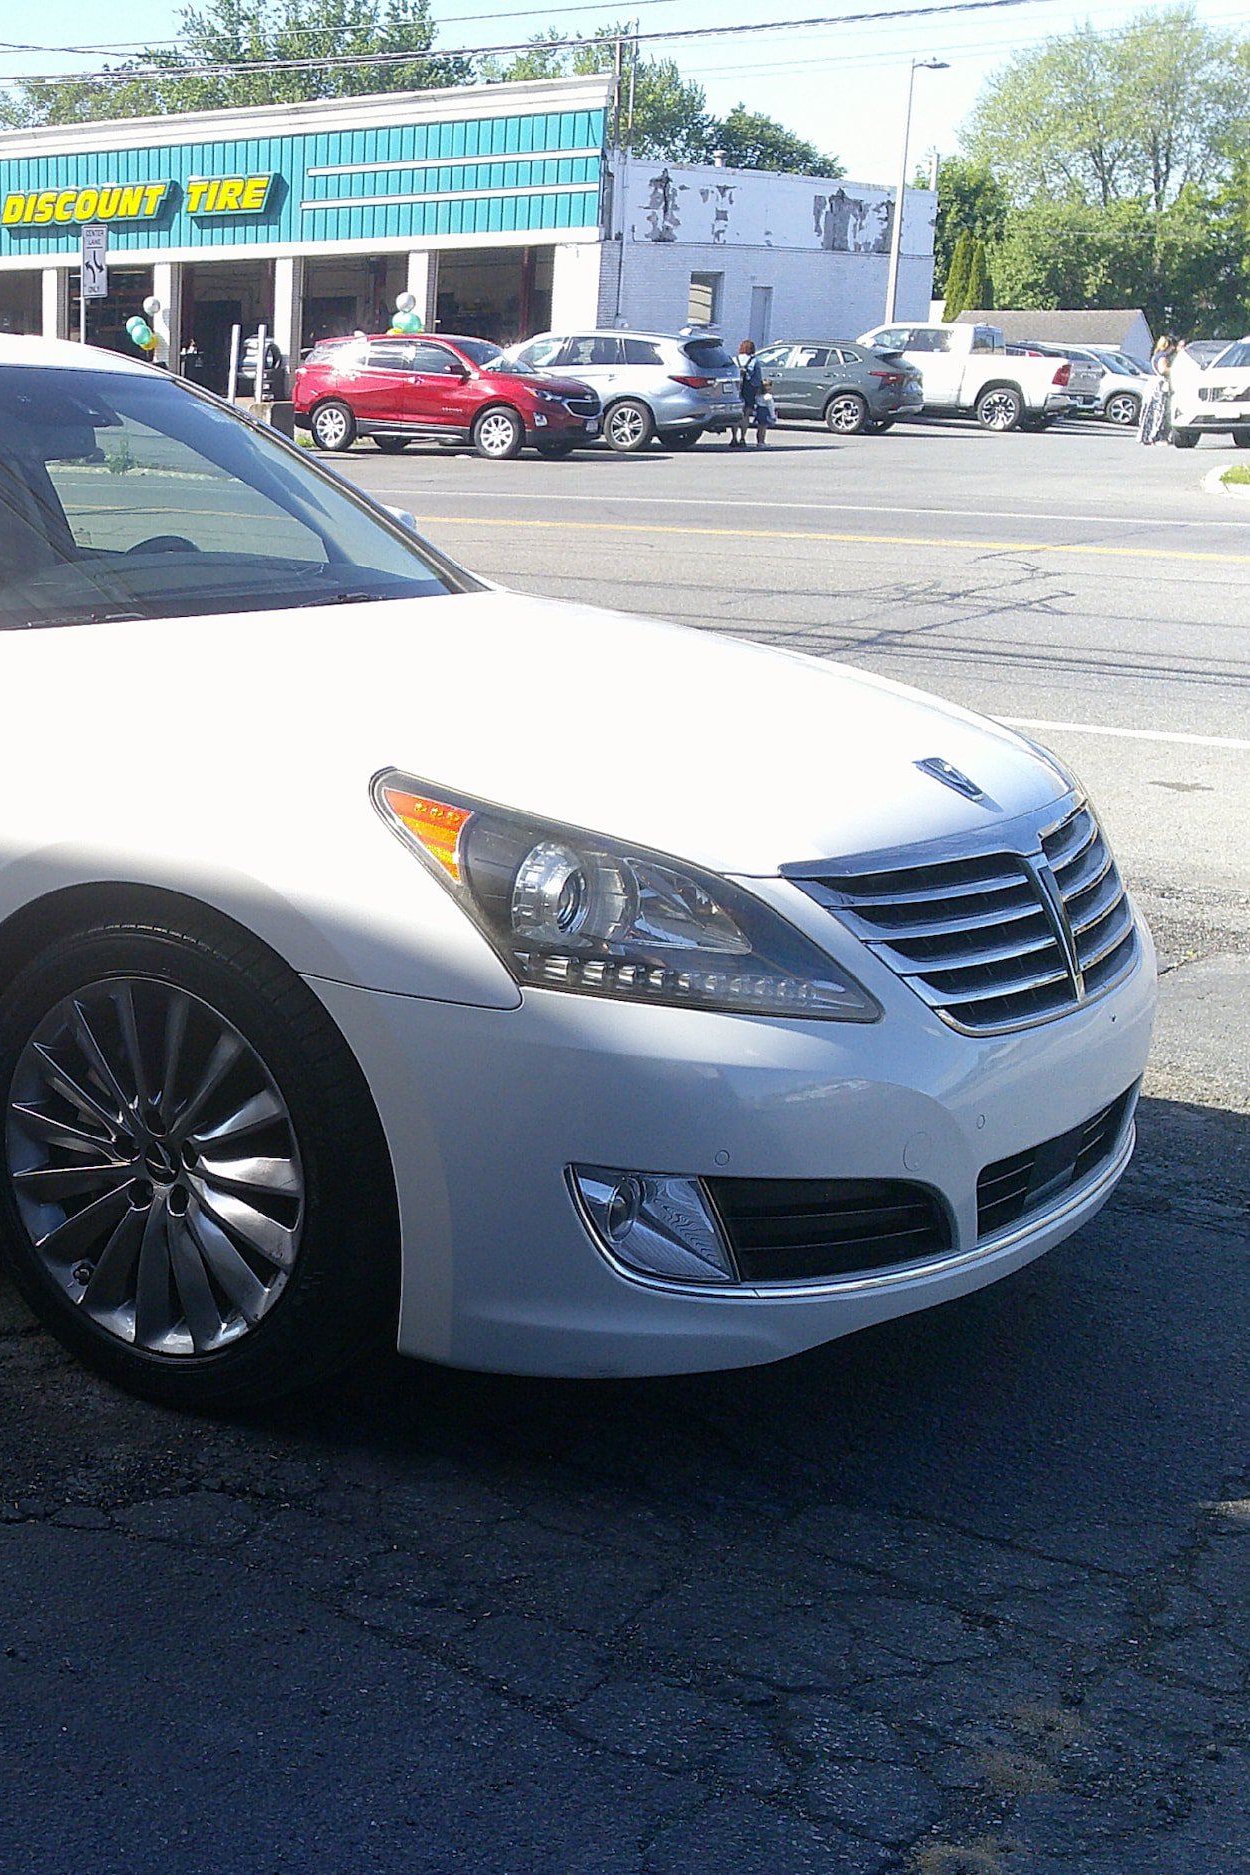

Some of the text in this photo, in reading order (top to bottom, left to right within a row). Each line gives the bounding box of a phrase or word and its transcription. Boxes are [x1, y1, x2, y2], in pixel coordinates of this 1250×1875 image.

[1, 184, 166, 224] DISCOUNT
[187, 176, 270, 212] TIRE
[85, 229, 104, 237] CENTER
